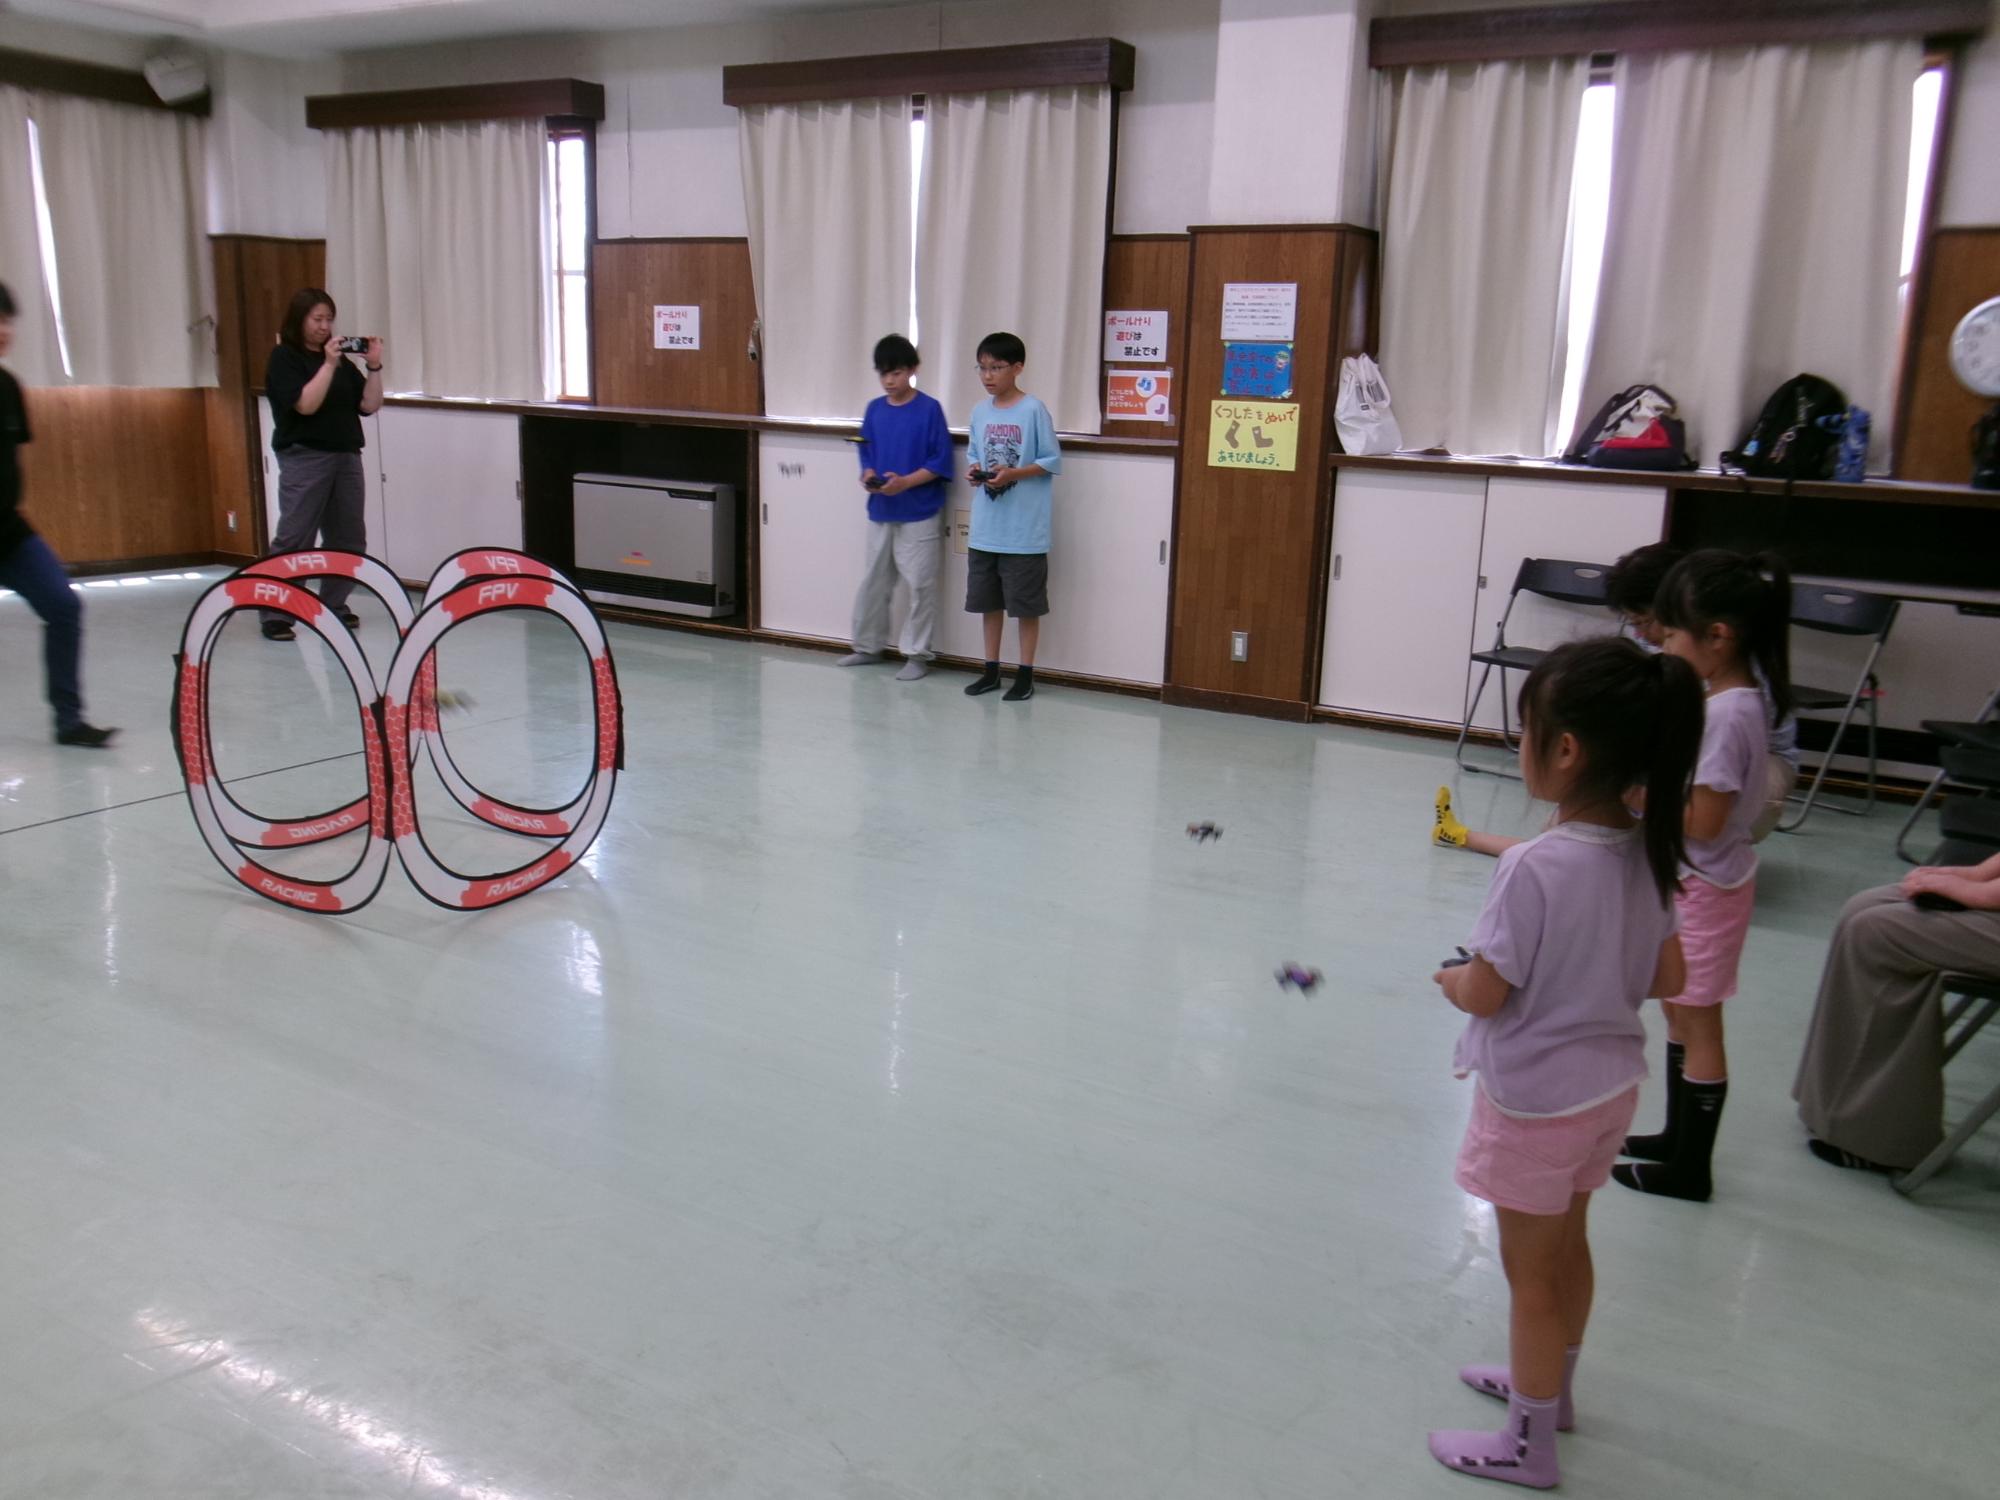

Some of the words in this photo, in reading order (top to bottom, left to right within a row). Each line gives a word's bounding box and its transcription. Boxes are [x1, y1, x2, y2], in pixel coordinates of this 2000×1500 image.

[1107, 315, 1152, 326] ボールけり
[669, 336, 695, 345] 禁止です
[1116, 331, 1142, 341] 遊びは
[1124, 346, 1159, 356] 禁止です
[1214, 404, 1298, 424] くつしたをぬいで
[254, 582, 290, 604] FPV
[478, 582, 520, 604] FPV
[485, 863, 548, 898] RACING
[260, 878, 317, 905] RACING
